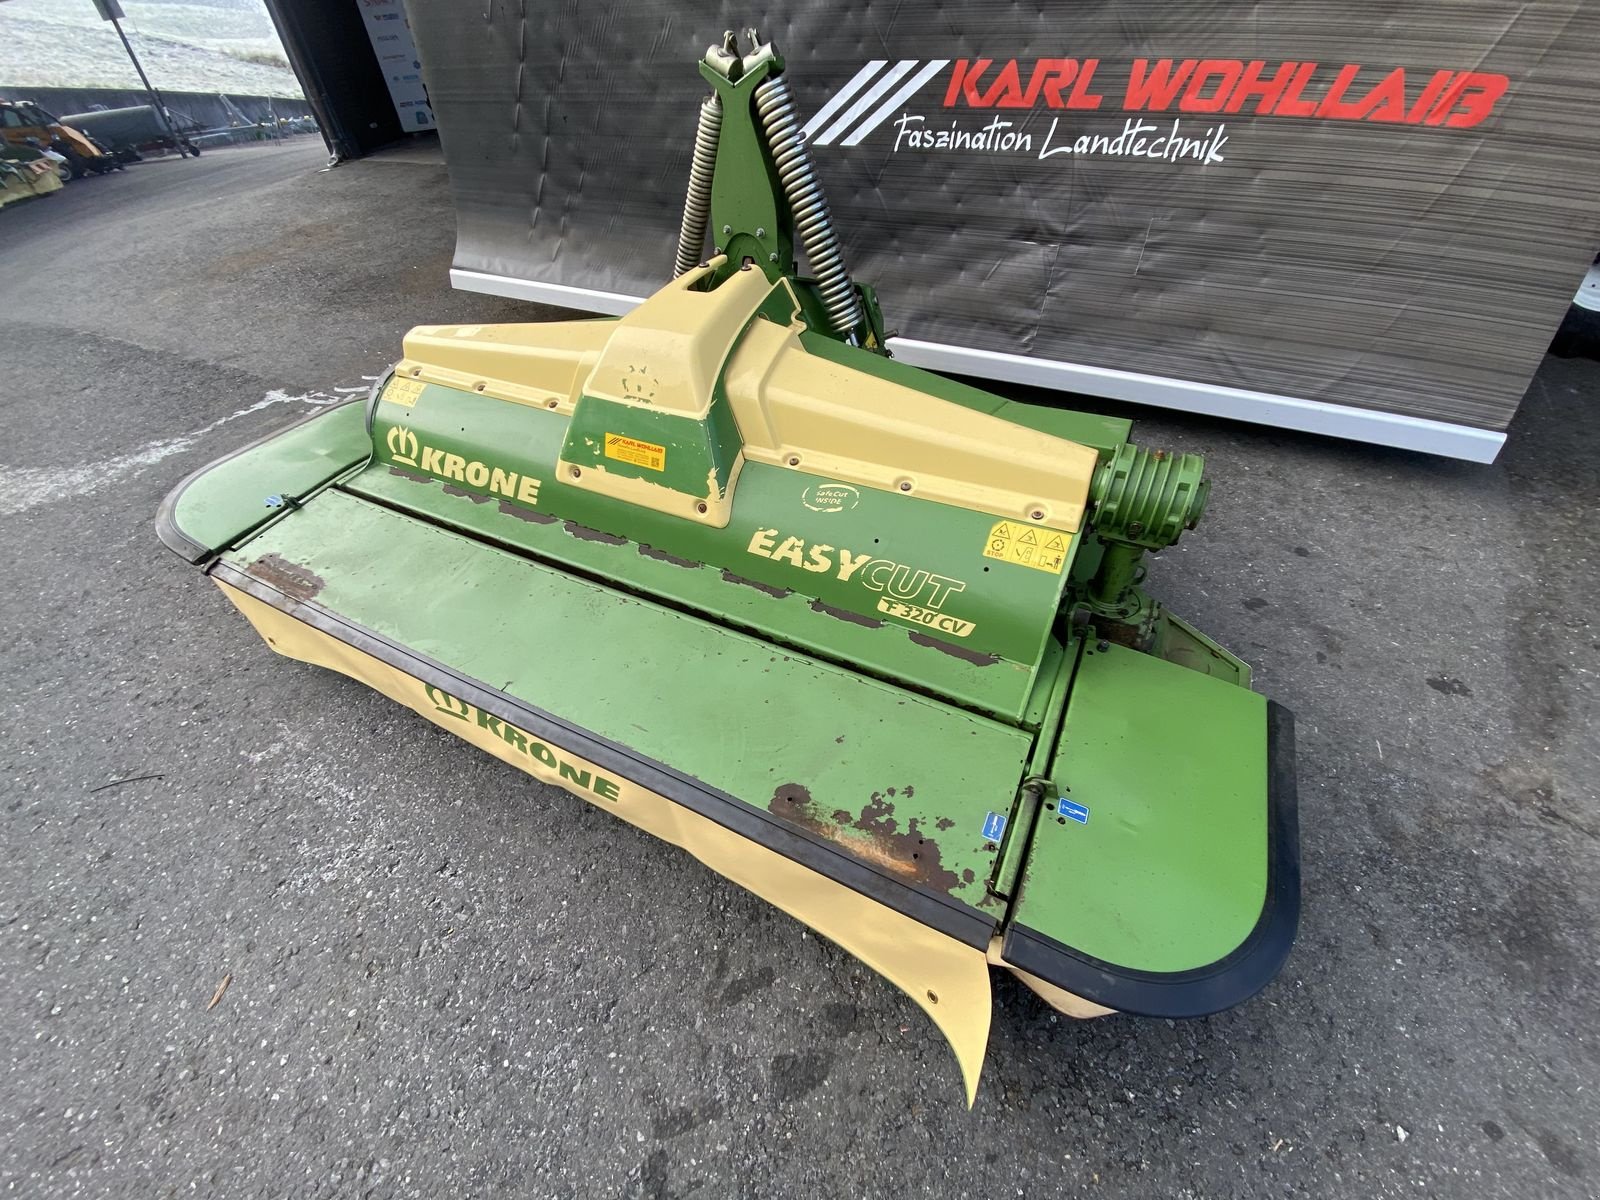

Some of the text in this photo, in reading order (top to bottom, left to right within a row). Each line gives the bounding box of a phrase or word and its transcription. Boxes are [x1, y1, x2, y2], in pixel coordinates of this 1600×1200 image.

[943, 58, 1510, 128] KARL WOHLLAIB
[893, 112, 1229, 165] Faszination Landtechnik
[421, 446, 542, 505] KRONE
[885, 600, 968, 634] F 320 CV
[476, 708, 621, 803] KRONE
